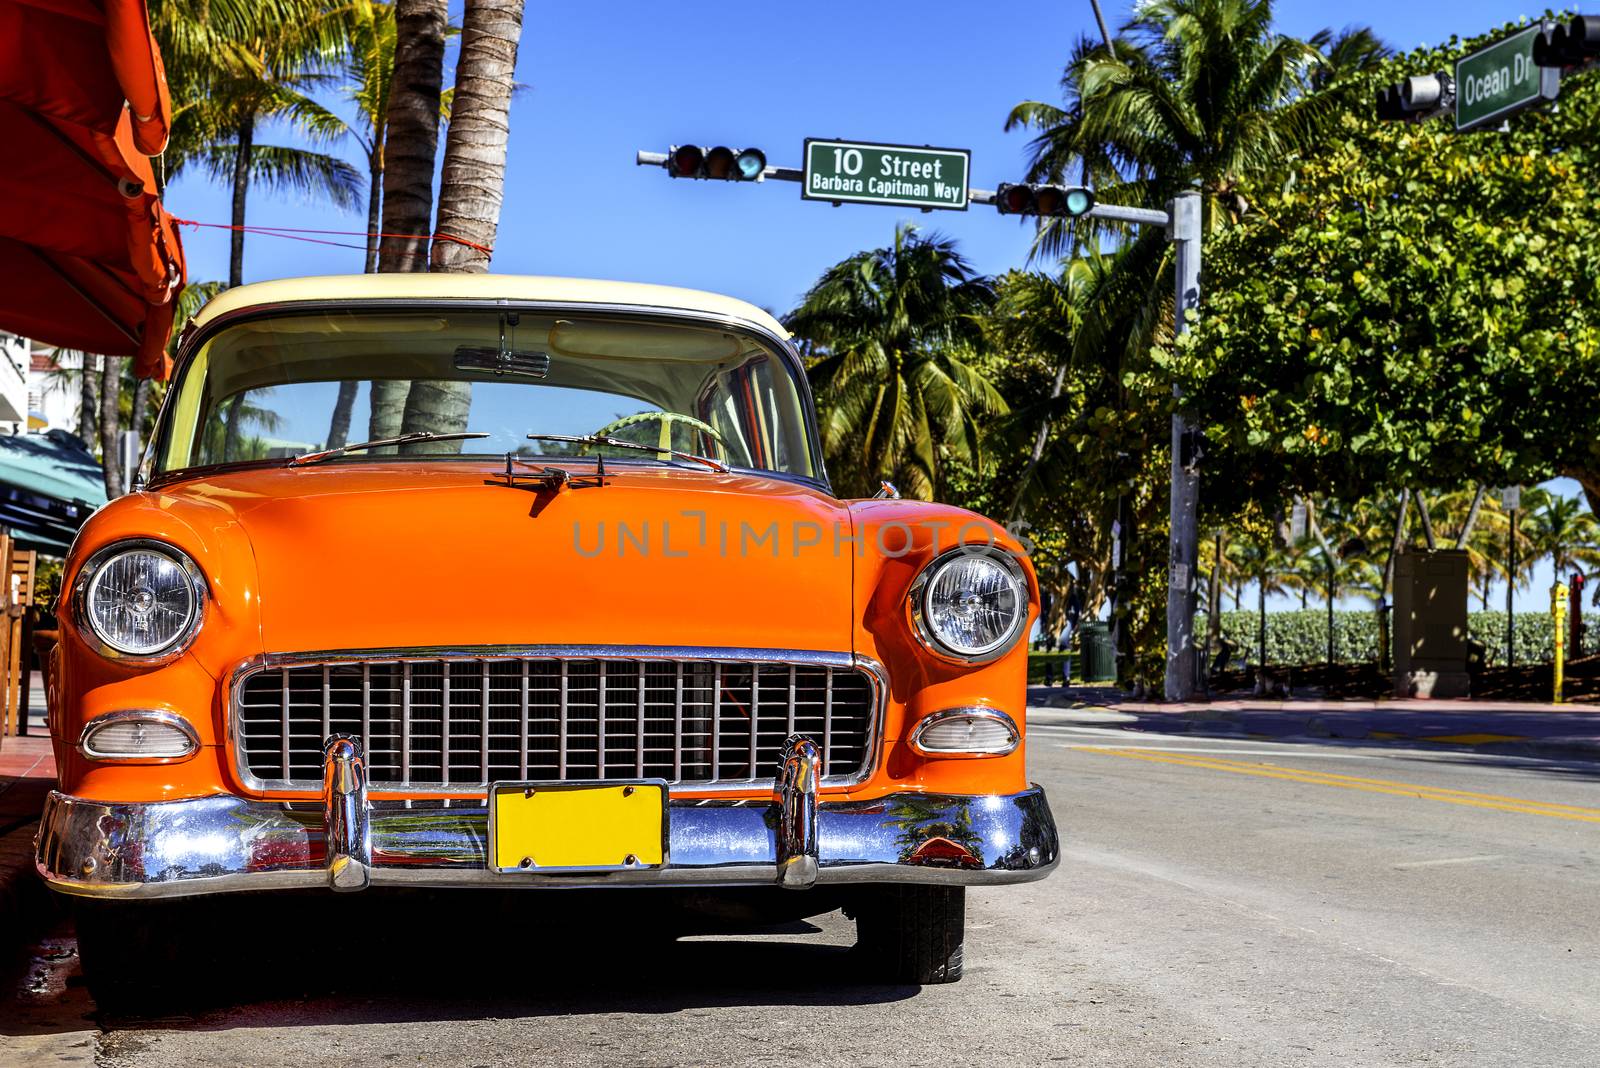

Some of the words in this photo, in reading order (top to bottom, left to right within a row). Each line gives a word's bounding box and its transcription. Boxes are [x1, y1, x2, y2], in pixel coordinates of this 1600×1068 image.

[1465, 66, 1510, 106] Ocean
[1514, 53, 1531, 86] Dr
[833, 149, 863, 176] 10
[880, 154, 943, 179] Street
[812, 173, 863, 192] Barbara
[868, 177, 928, 197] Capitman
[934, 182, 960, 203] Way
